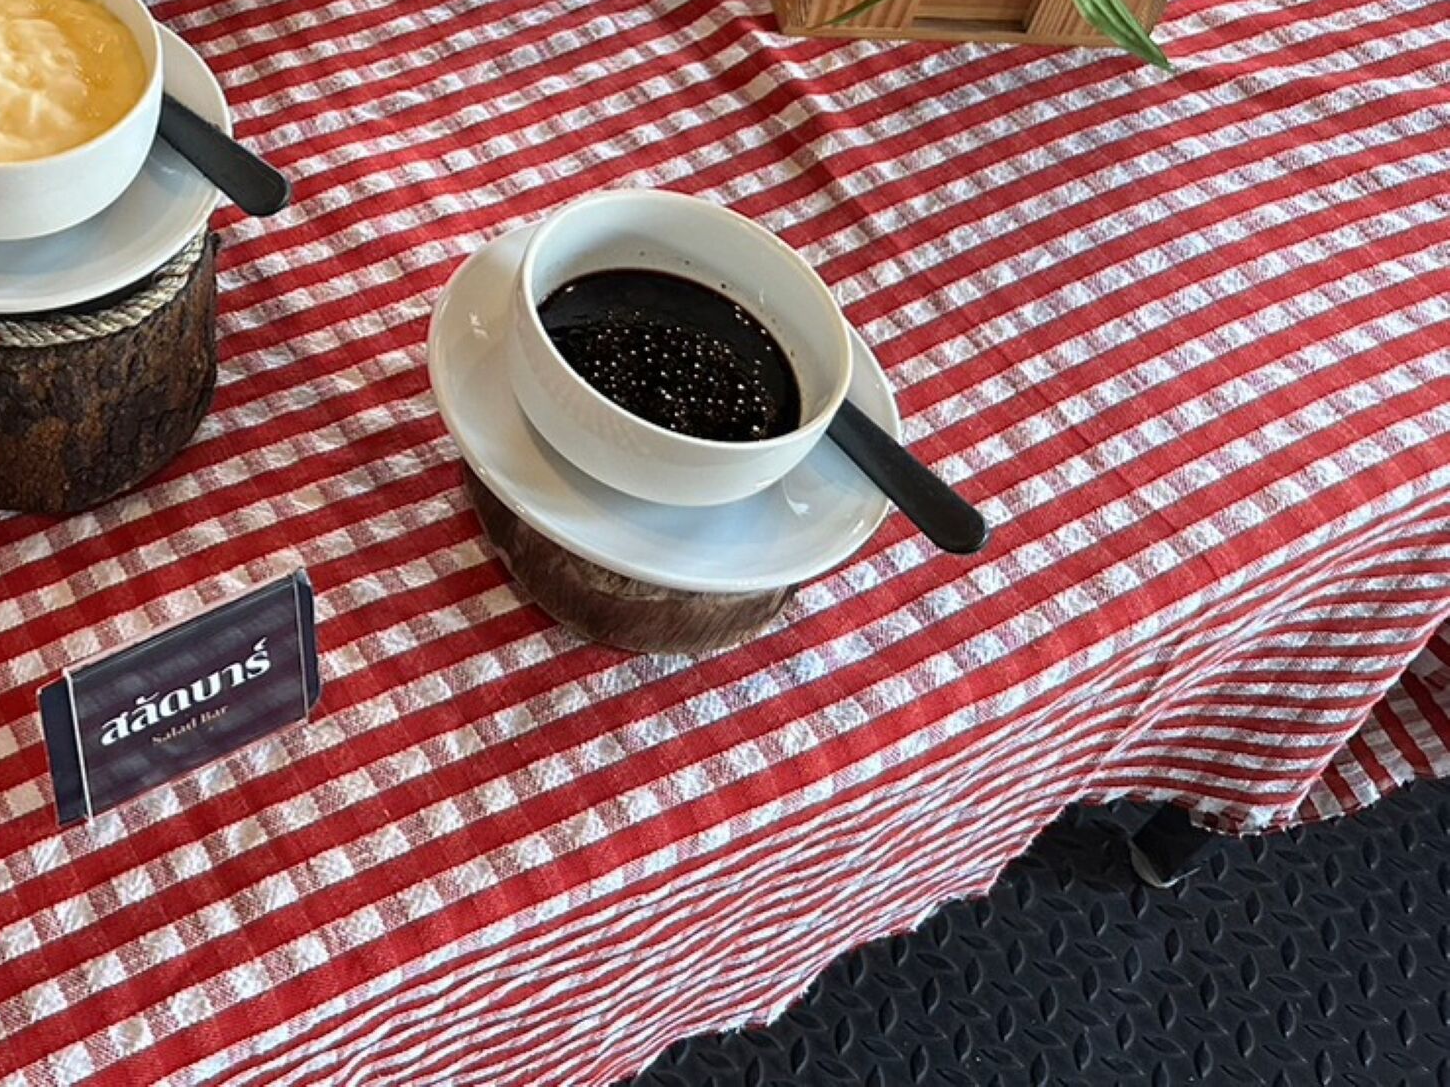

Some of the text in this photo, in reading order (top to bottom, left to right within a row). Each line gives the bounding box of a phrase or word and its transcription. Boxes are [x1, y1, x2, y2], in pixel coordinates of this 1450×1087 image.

[101, 637, 271, 746] สลัดบาร์
[151, 705, 229, 744] Salad Bar
